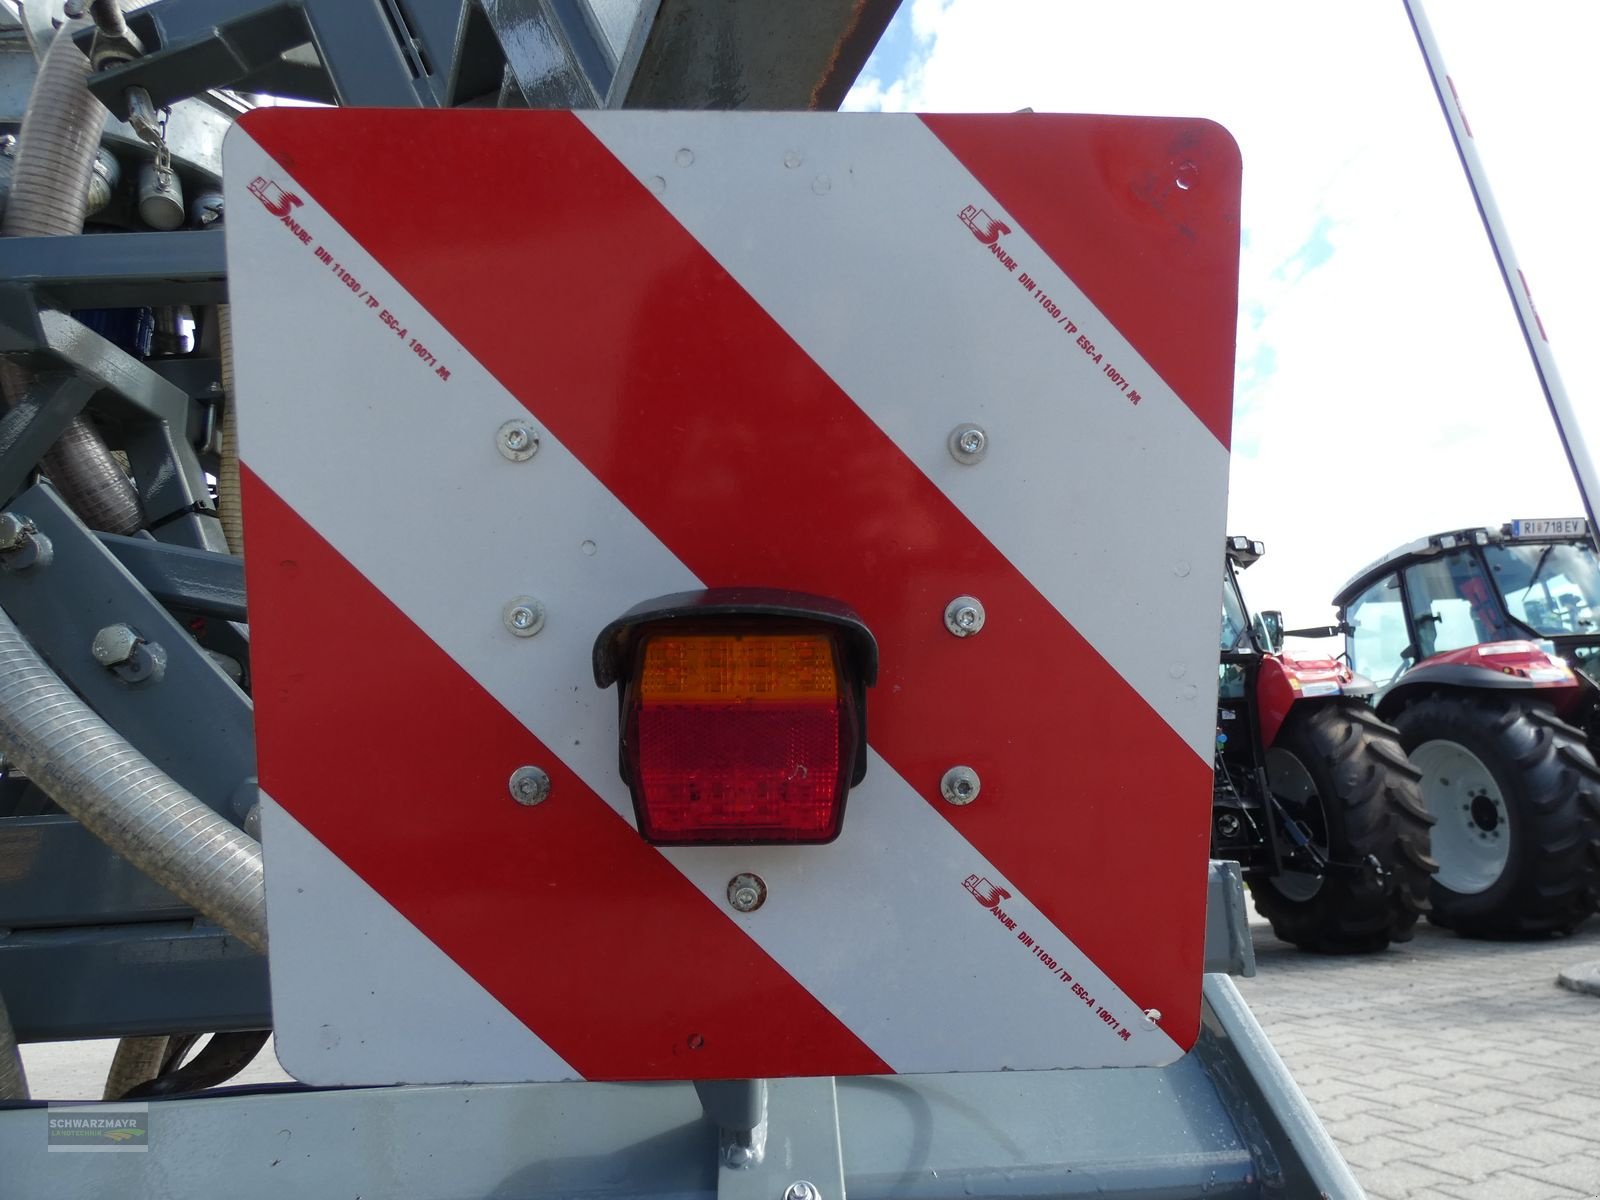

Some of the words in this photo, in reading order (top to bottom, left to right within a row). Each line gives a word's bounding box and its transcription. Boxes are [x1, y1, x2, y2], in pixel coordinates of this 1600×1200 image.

[314, 246, 333, 266] DIN
[332, 263, 361, 292] 11030
[365, 295, 380, 310] TP
[378, 310, 408, 339] ESC-A
[408, 339, 437, 367] 10071
[1018, 272, 1036, 292] DIN
[1033, 289, 1061, 319] 11030
[1063, 320, 1078, 335] TP
[1076, 335, 1103, 364] ESC-A
[1102, 363, 1129, 392] 10071
[1524, 522, 1535, 534] RI
[1017, 931, 1034, 948] DIN
[1032, 945, 1057, 970] 11030
[1059, 970, 1073, 983] TP
[1070, 983, 1096, 1008] ESC-A
[1095, 1006, 1120, 1030] 10071
